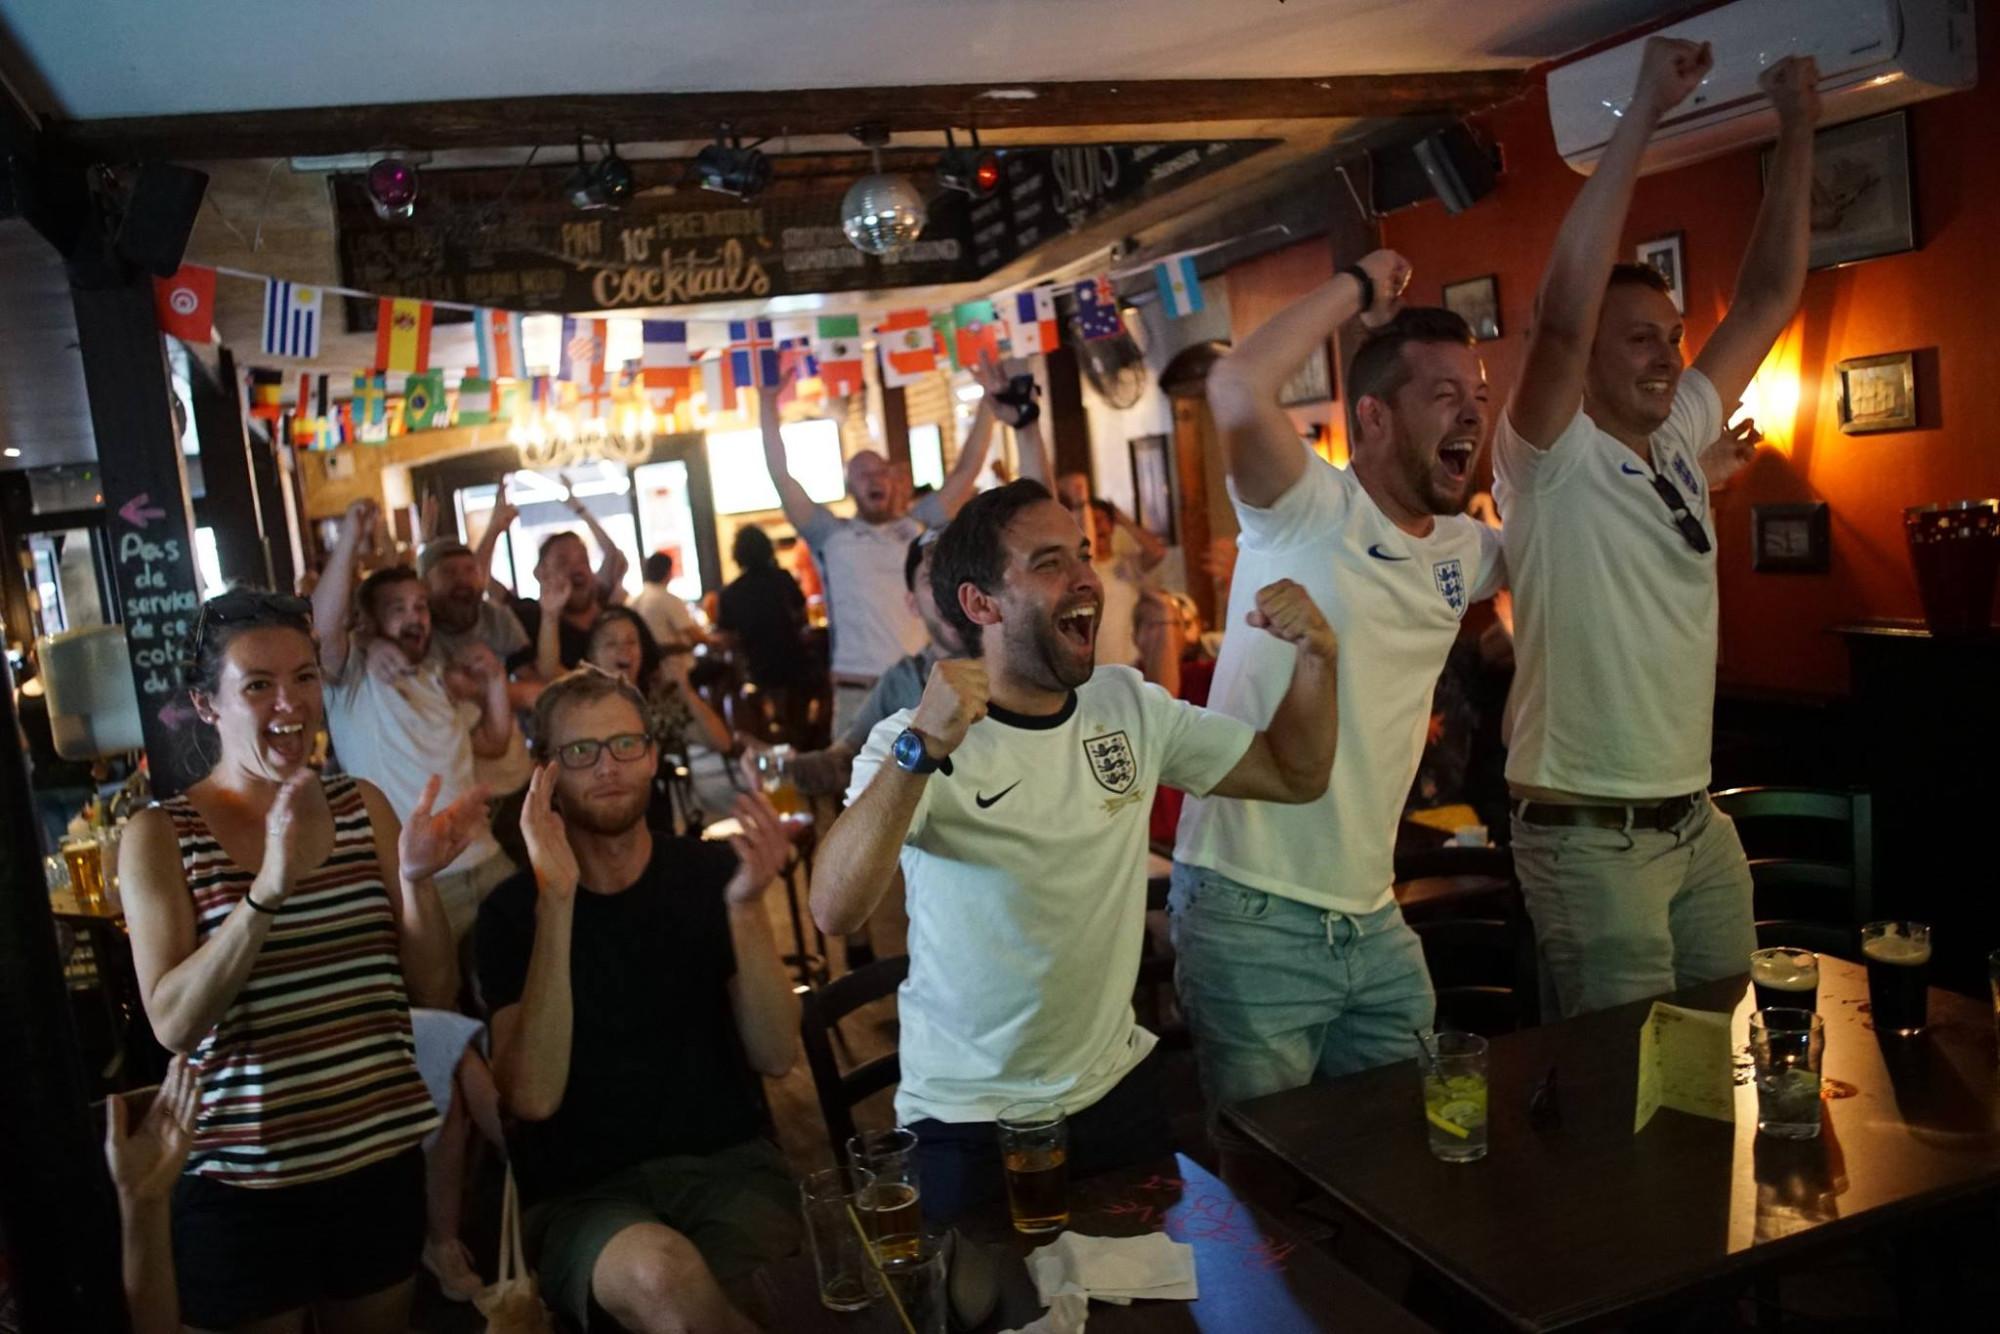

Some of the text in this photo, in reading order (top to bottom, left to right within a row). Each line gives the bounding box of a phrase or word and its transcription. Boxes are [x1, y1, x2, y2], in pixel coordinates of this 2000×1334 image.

[121, 532, 180, 564] Pas
[134, 563, 168, 590] de
[126, 590, 197, 617] service
[130, 618, 155, 639] de
[143, 668, 170, 694] du
